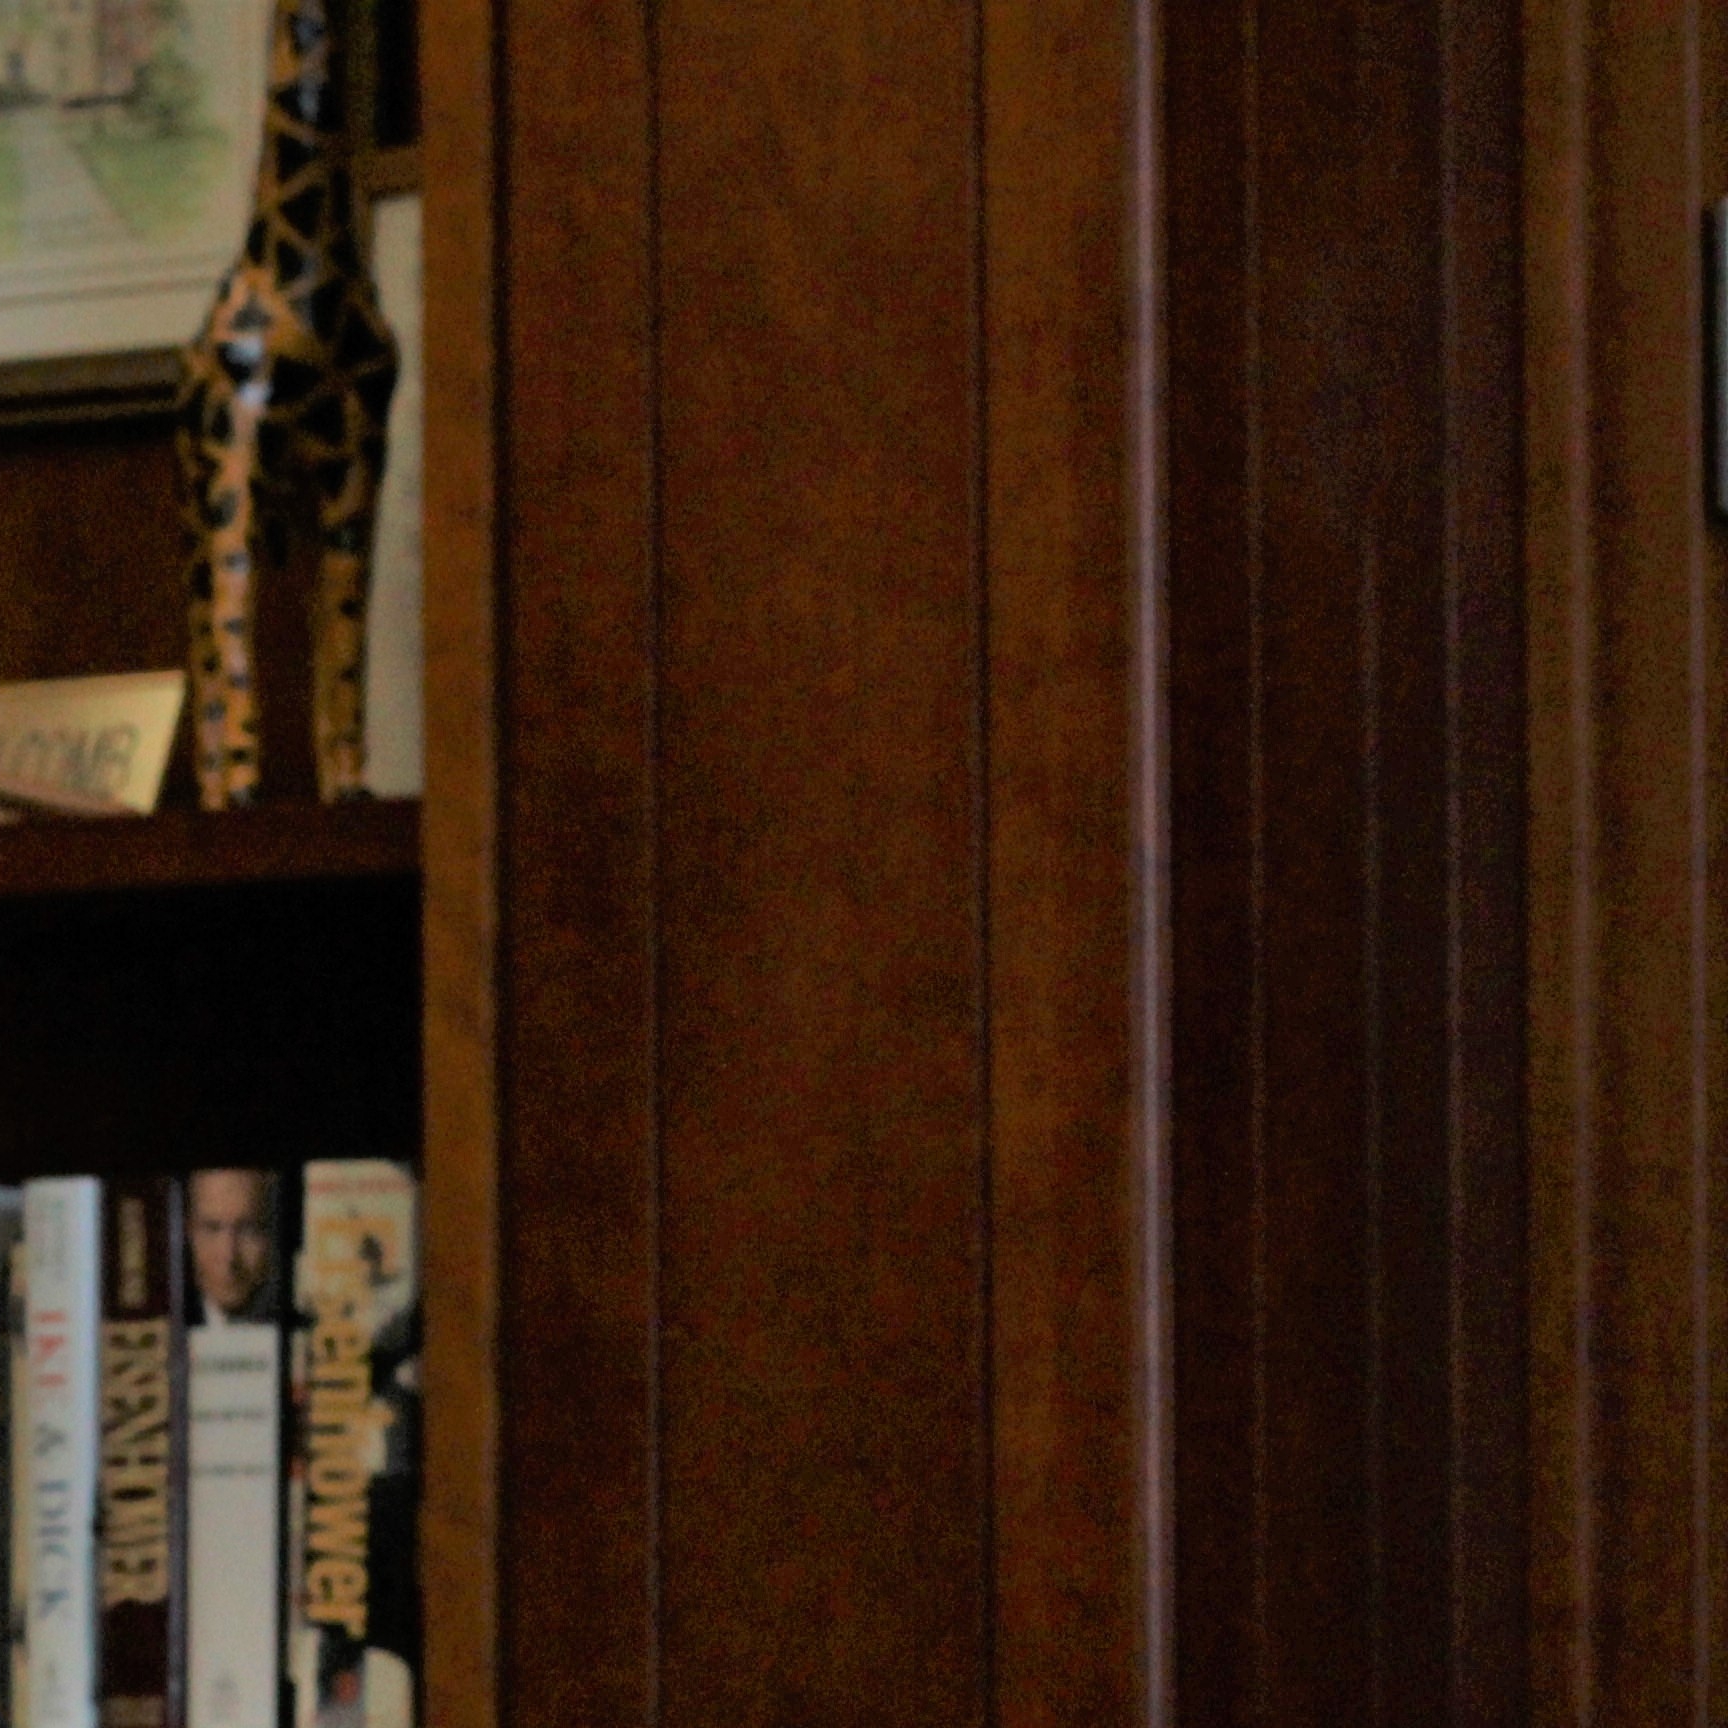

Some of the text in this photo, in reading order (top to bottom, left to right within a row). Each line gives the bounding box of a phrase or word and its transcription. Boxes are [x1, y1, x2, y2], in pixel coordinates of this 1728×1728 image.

[36, 1479, 71, 1623] DICK
[100, 1318, 170, 1606] EISENHOWER
[302, 1210, 402, 1640] Eisenhower
